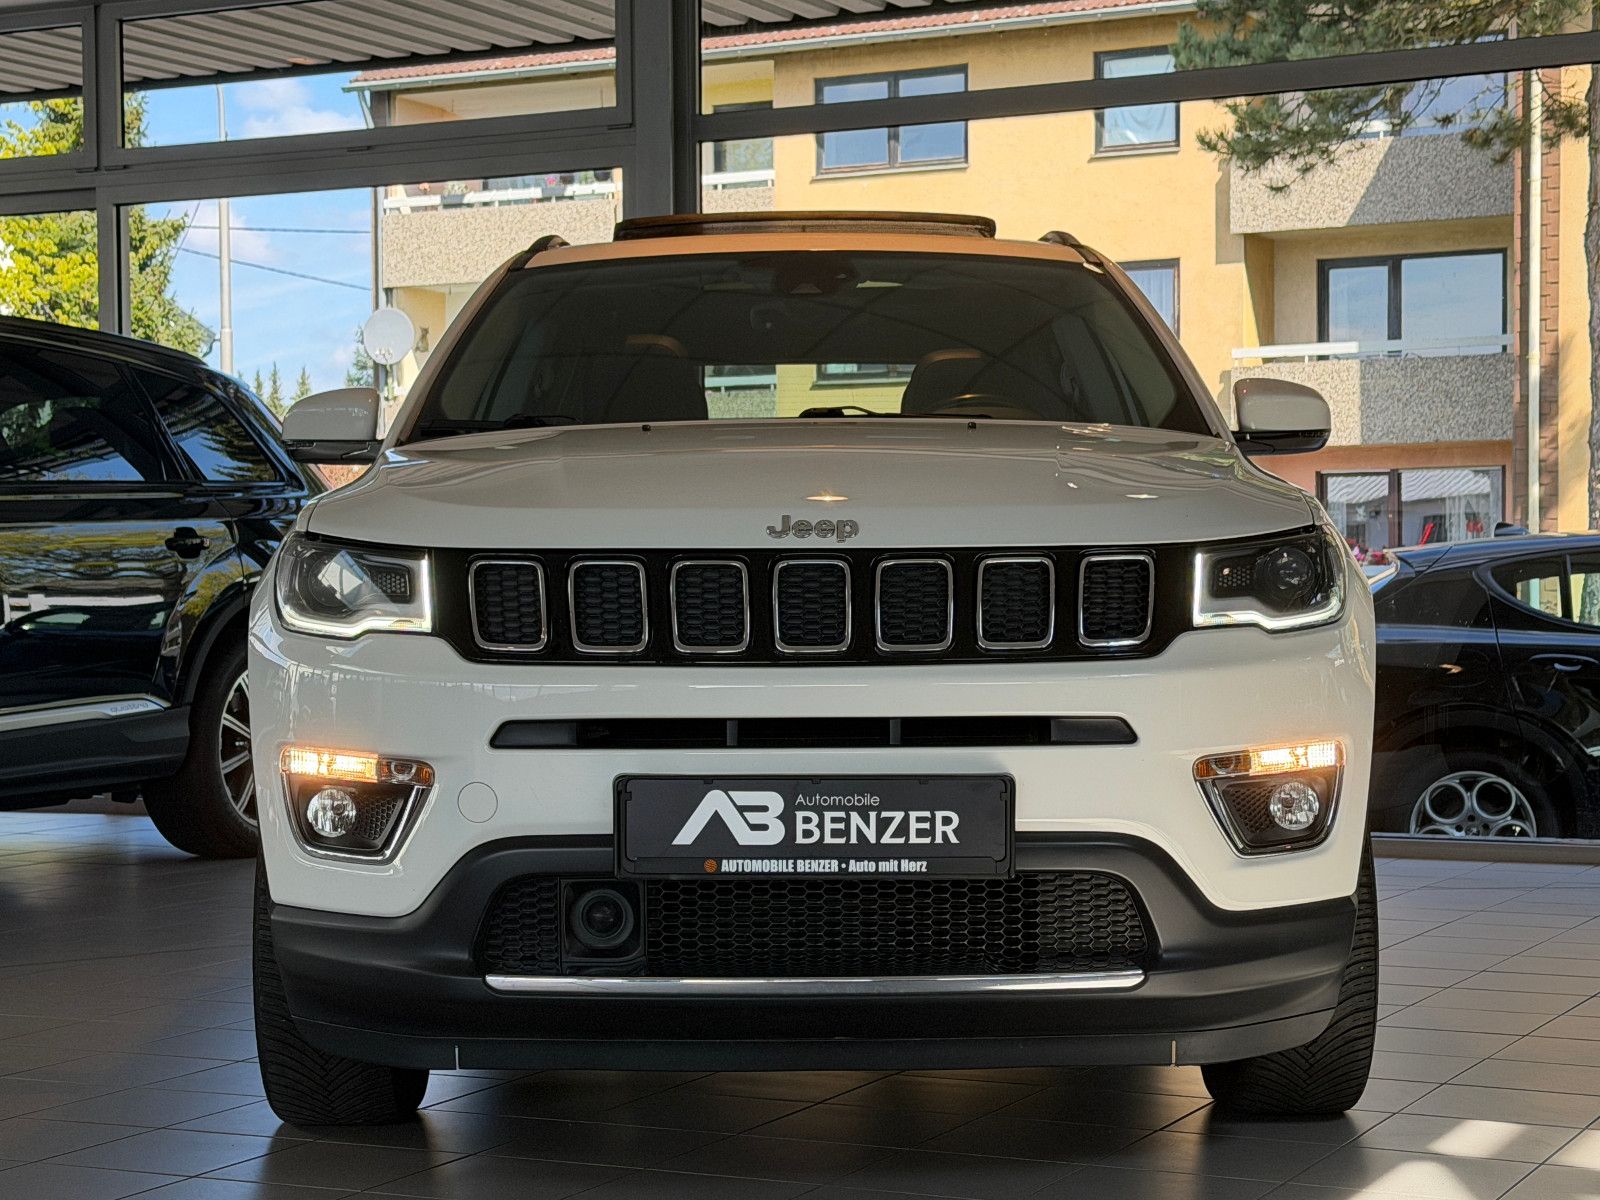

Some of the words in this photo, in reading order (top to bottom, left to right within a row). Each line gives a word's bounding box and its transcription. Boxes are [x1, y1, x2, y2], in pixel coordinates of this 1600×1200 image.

[766, 514, 859, 543] Jeep
[794, 793, 880, 807] Automobile
[794, 810, 961, 845] BENZER
[720, 858, 795, 873] AUTOMOBILE
[796, 858, 839, 873] BENZER
[848, 858, 876, 873] Auto
[878, 858, 899, 873] mit
